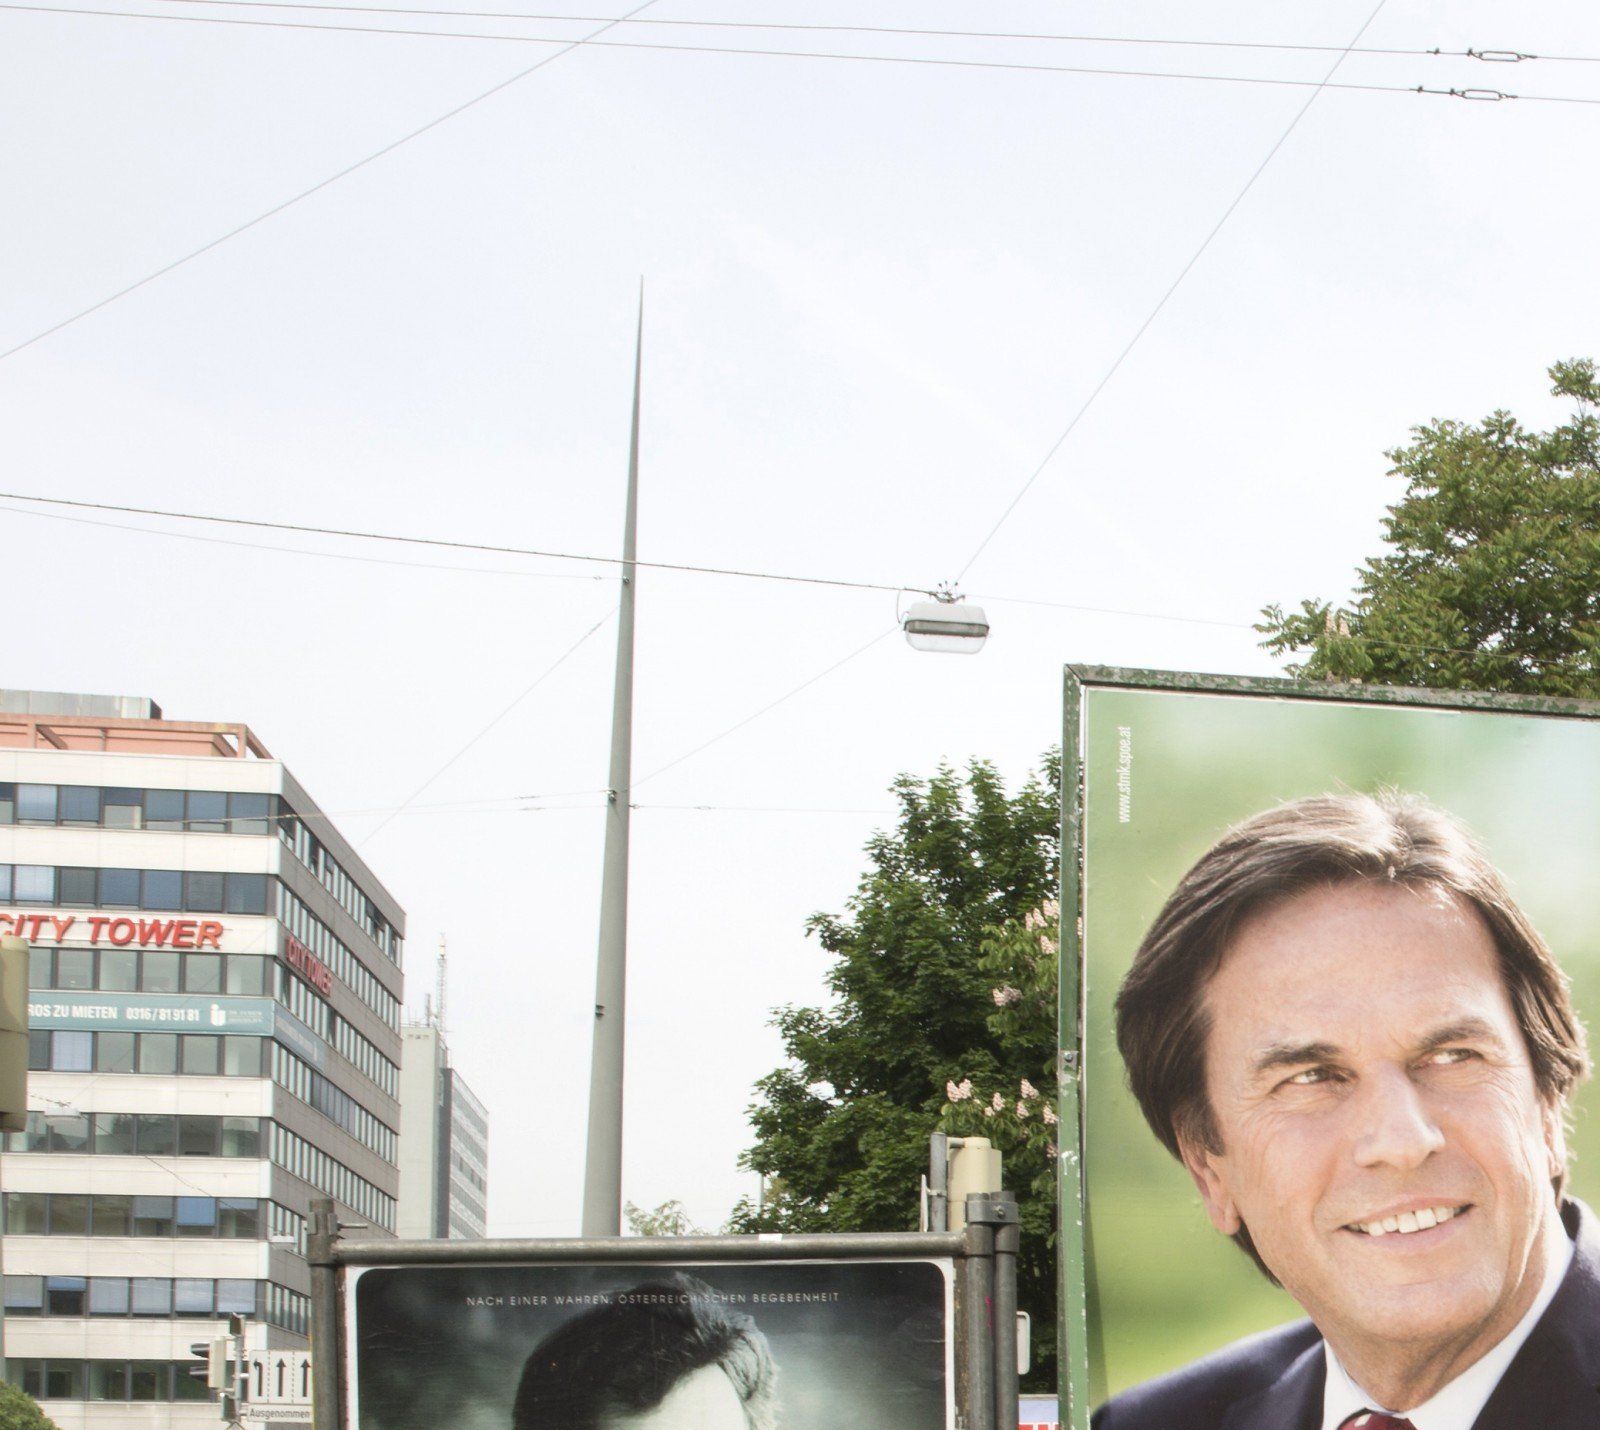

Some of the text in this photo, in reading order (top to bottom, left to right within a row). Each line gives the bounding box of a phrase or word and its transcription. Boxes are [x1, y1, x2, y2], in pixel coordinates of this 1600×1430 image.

[87, 916, 224, 949] TOWER
[52, 1004, 69, 1018] ZU
[71, 1005, 118, 1020] MIETEN
[466, 1296, 503, 1306] NACH
[510, 1296, 548, 1306] EINER
[753, 1292, 839, 1303] BEGEBENHEIT
[250, 1408, 311, 1420] Ausgenommen
